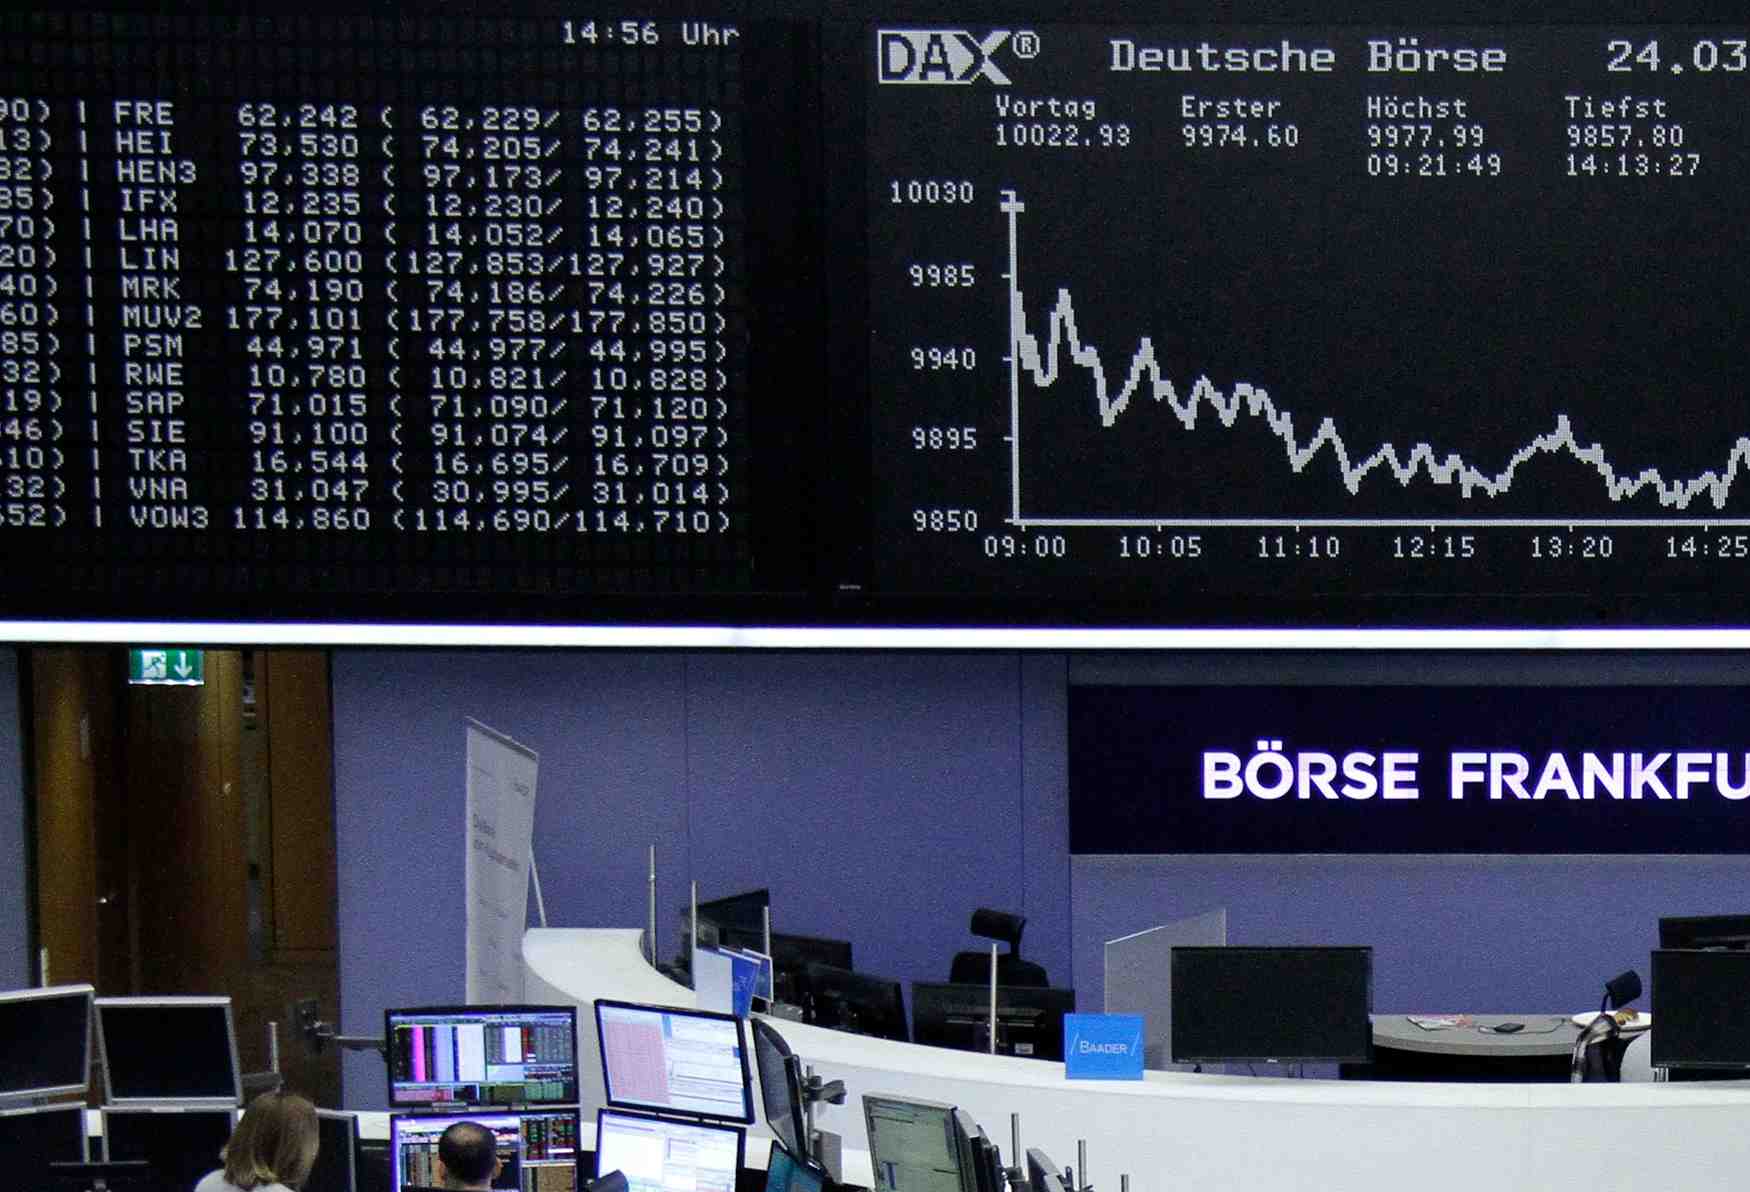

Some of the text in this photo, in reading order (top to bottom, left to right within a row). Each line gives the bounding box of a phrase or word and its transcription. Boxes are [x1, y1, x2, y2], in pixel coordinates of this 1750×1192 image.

[563, 20, 740, 46] 14:56 Uhr
[1109, 39, 1336, 73] Deutsche
[1367, 37, 1507, 73] Börse
[114, 100, 358, 129] FRE 62,242
[995, 94, 1096, 121] Vortag
[1181, 95, 1281, 119] Erster
[1367, 95, 1467, 119] Höchst
[1564, 95, 1667, 119] Tiefst
[115, 130, 359, 158] HEI 73,530
[996, 123, 1131, 147] 10022.93
[1181, 123, 1299, 148] 9974.60
[1367, 124, 1484, 148] 9977.99
[1567, 124, 1684, 148] 9857.80
[116, 159, 360, 187] HEN3 97,338
[1367, 153, 1501, 177] 09:21:49
[1567, 153, 1700, 177] 14:13:27
[121, 188, 361, 216] IFX 12,235
[891, 180, 974, 204] 10030
[119, 217, 362, 245] LHA 14,070
[120, 247, 180, 271] LIN
[225, 248, 363, 273] 127,600
[121, 275, 364, 302] MRK 74,190
[909, 264, 975, 287] 9985
[122, 304, 203, 329] MUV2
[228, 306, 361, 331] 177,101
[124, 333, 363, 360] PSM 44,971
[910, 347, 976, 370] 9940
[125, 362, 366, 388] RWE 10,780
[126, 390, 367, 417] SAP 71,015
[127, 419, 368, 445] SIE 91,100
[911, 427, 977, 450] 9895
[128, 448, 369, 474] TKA 16,544
[129, 476, 369, 502] VNA 31,047
[130, 505, 209, 529] VOW3
[234, 506, 370, 531] 114,860
[913, 509, 978, 532] 9850
[984, 535, 1066, 558] 09:00
[1119, 535, 1202, 558] 10:05
[1258, 535, 1340, 558] 11:10
[1393, 535, 1475, 558] 12:15
[1531, 535, 1613, 558] 13:20
[1667, 535, 1748, 558] 14:25
[1202, 740, 1419, 800] BÖRSE
